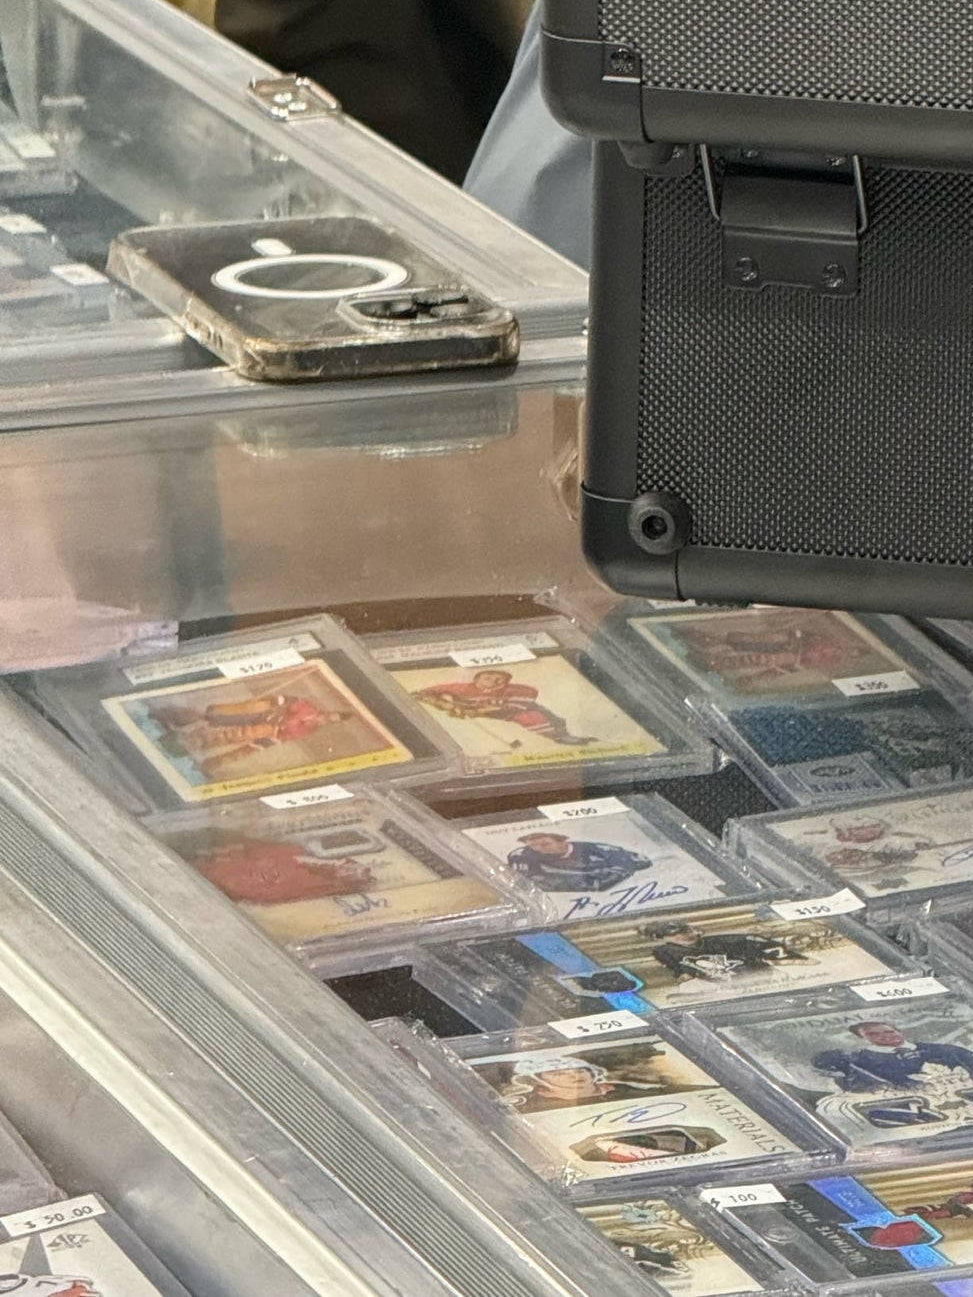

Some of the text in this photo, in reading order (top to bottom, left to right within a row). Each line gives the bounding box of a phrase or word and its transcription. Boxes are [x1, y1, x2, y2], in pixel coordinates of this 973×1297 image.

[795, 905, 832, 915] $150
[876, 988, 913, 999] $600
[698, 1092, 787, 1153] MATERIALS
[815, 1224, 868, 1264] ULTIMATE
